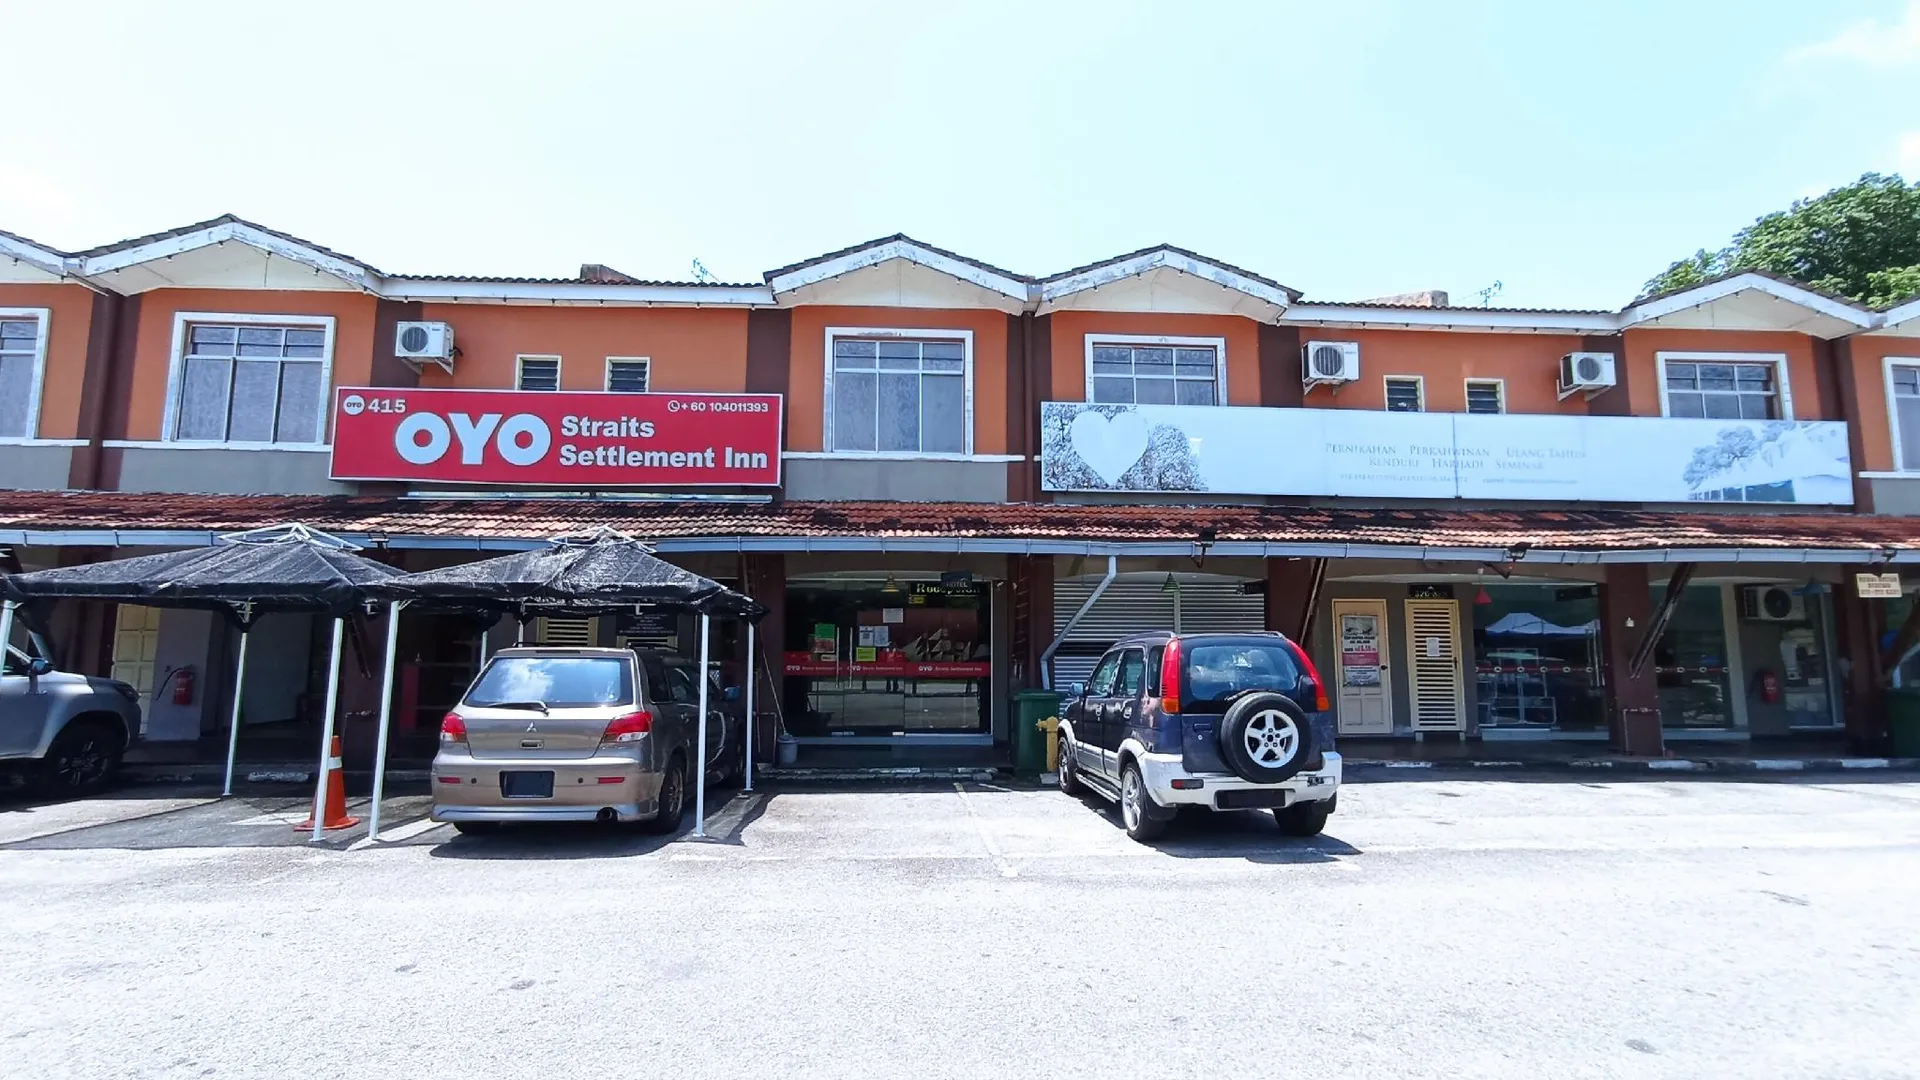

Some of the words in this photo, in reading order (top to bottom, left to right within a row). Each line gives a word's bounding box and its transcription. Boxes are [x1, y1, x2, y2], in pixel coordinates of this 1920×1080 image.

[368, 399, 406, 413] 415
[690, 401, 706, 412] 60
[561, 415, 655, 437] Straits
[394, 411, 551, 466] OYO
[559, 443, 715, 468] Settlement
[724, 447, 768, 468] Inn
